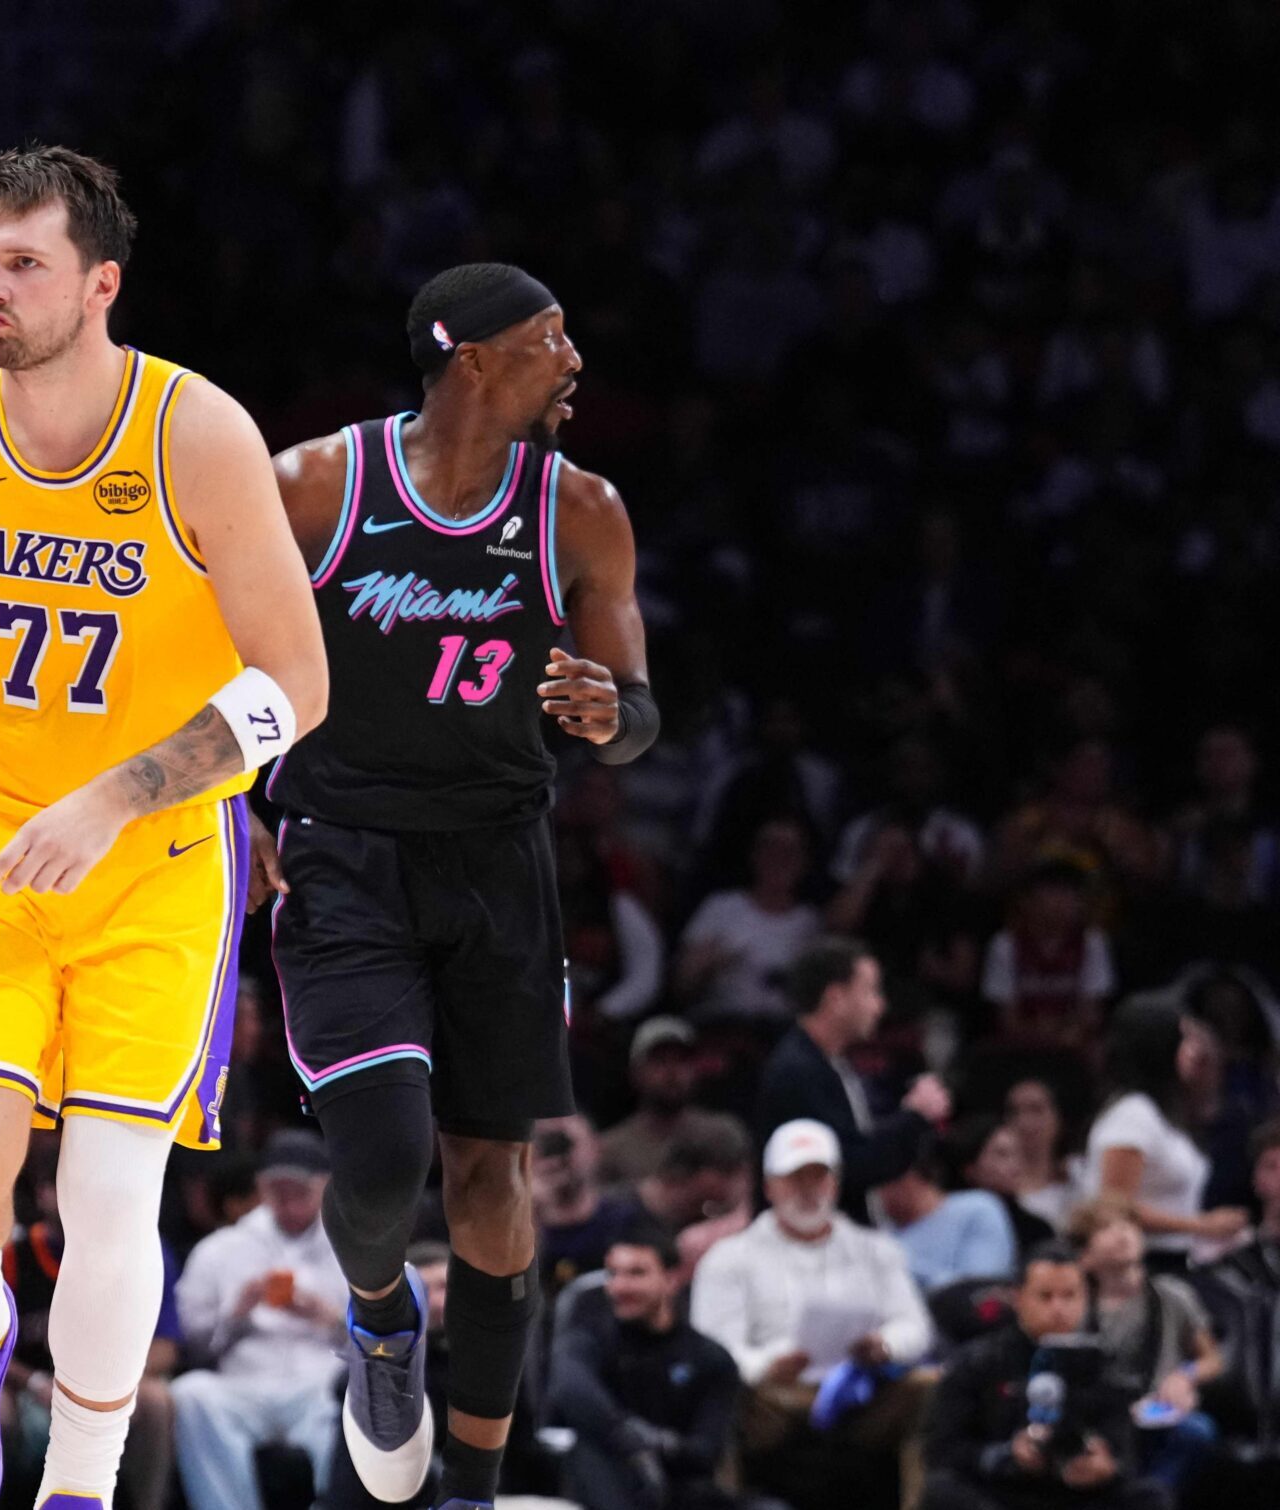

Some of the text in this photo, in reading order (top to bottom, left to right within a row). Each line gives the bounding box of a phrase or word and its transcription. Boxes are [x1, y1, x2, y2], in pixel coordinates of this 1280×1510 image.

[99, 482, 147, 501] bibigo
[486, 545, 532, 560] Robinhood
[342, 570, 523, 635] Miami
[426, 634, 515, 706] 13
[247, 706, 281, 745] 77
